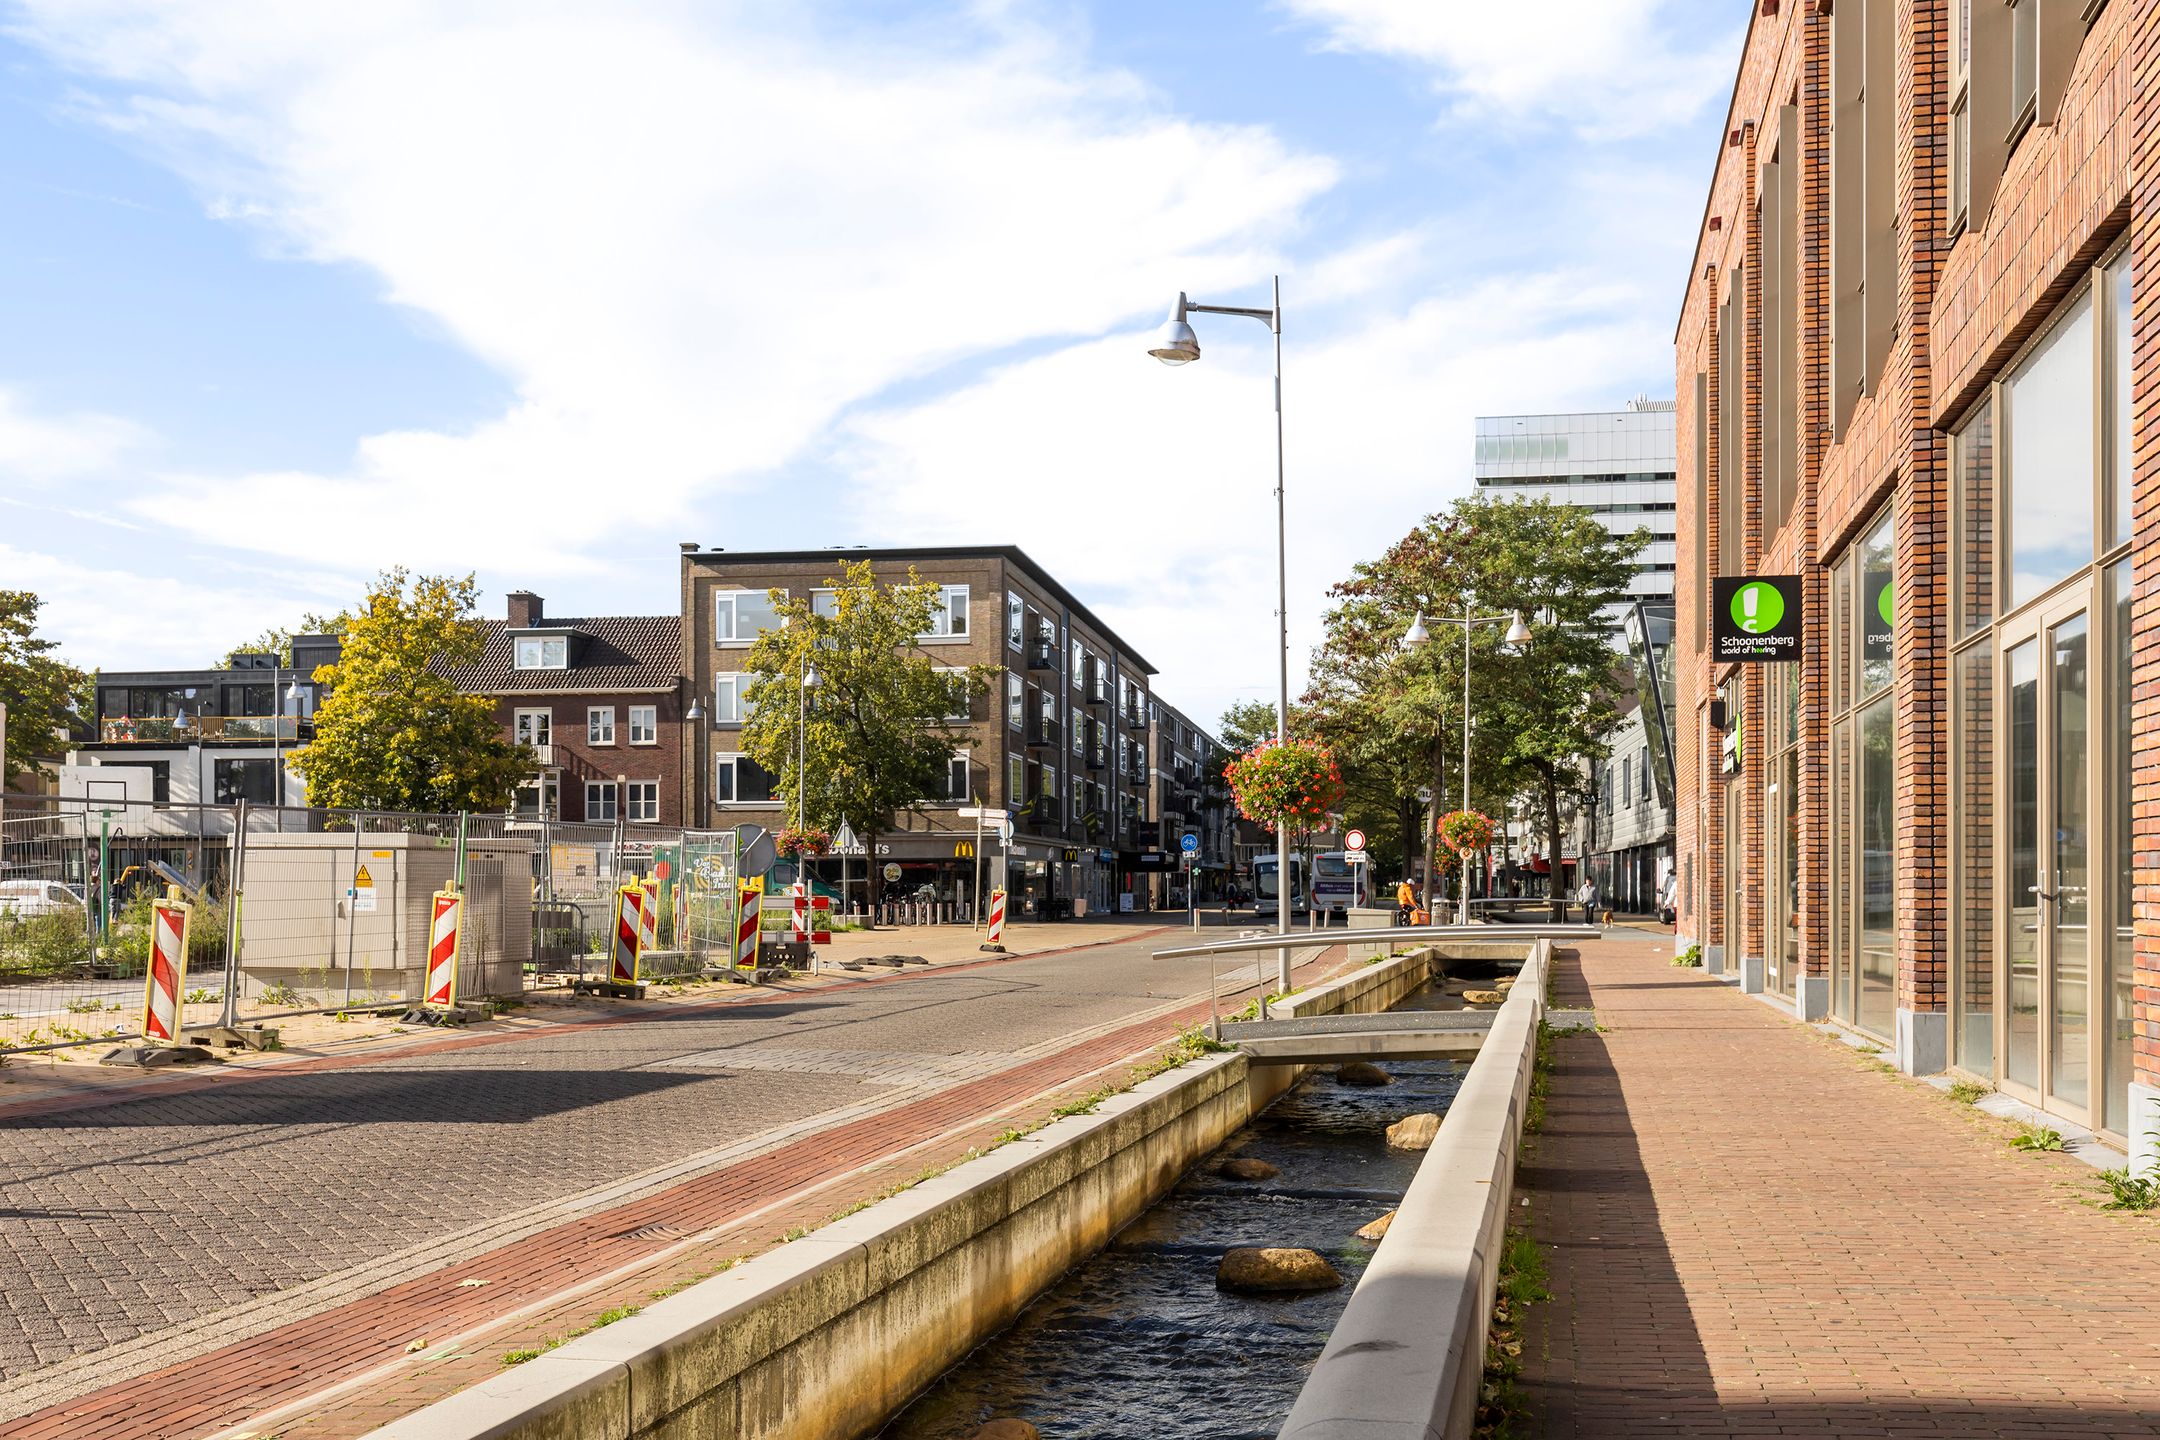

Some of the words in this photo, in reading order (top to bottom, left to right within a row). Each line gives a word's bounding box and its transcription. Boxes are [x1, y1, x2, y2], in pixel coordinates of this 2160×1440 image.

[1721, 635, 1794, 647] Schoonenberg
[1721, 646, 1740, 655] world
[1742, 646, 1751, 655] of
